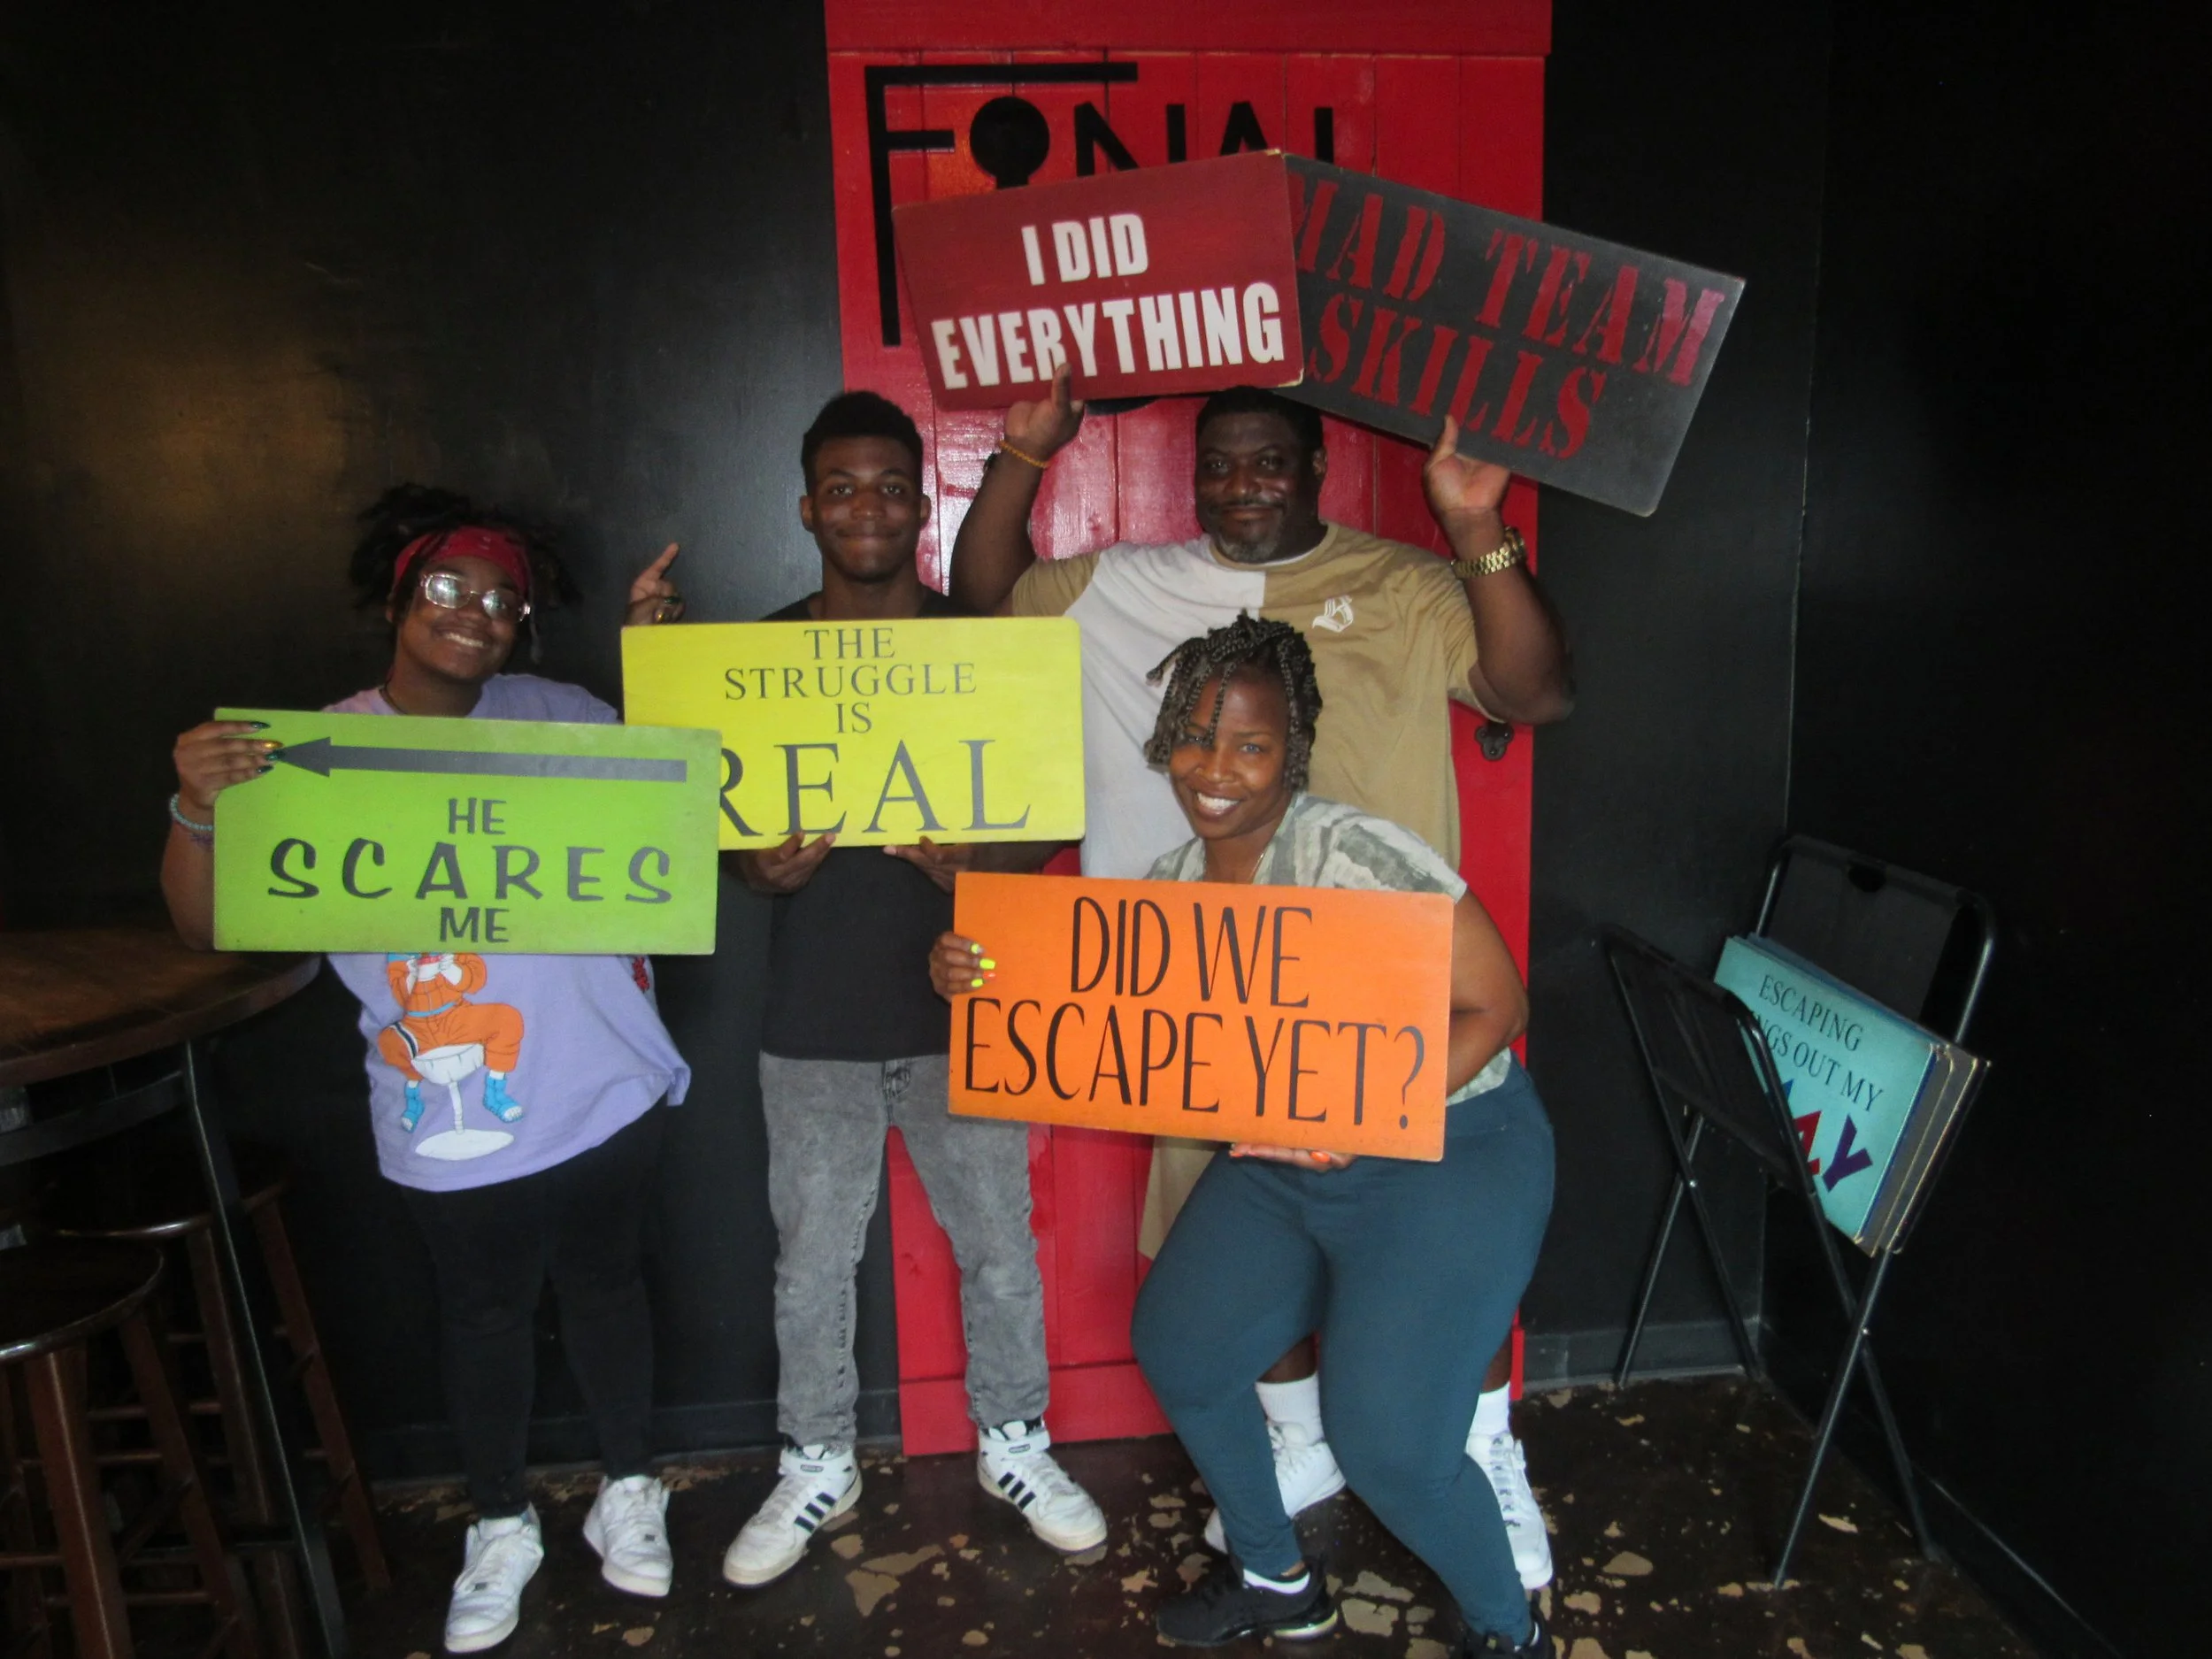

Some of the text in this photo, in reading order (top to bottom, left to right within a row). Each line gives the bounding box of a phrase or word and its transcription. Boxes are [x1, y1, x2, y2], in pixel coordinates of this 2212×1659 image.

[1021, 212, 1149, 287] I DID
[931, 281, 1285, 390] EVERYTHING
[1474, 228, 1725, 387] TEAM
[1305, 292, 1609, 460] SKILLS
[803, 626, 896, 661] THE
[724, 662, 978, 701] STRUGGLE
[835, 702, 872, 735] IS
[447, 797, 507, 835] HE
[267, 837, 672, 904] SCARES
[439, 905, 510, 944] ME
[1070, 895, 1313, 1009] DID WE
[1758, 974, 1863, 1052] ESCAPING
[964, 996, 1425, 1131] ESCAPE YET?
[1793, 1041, 1842, 1086] OUT
[1840, 1070, 1886, 1112] MY
